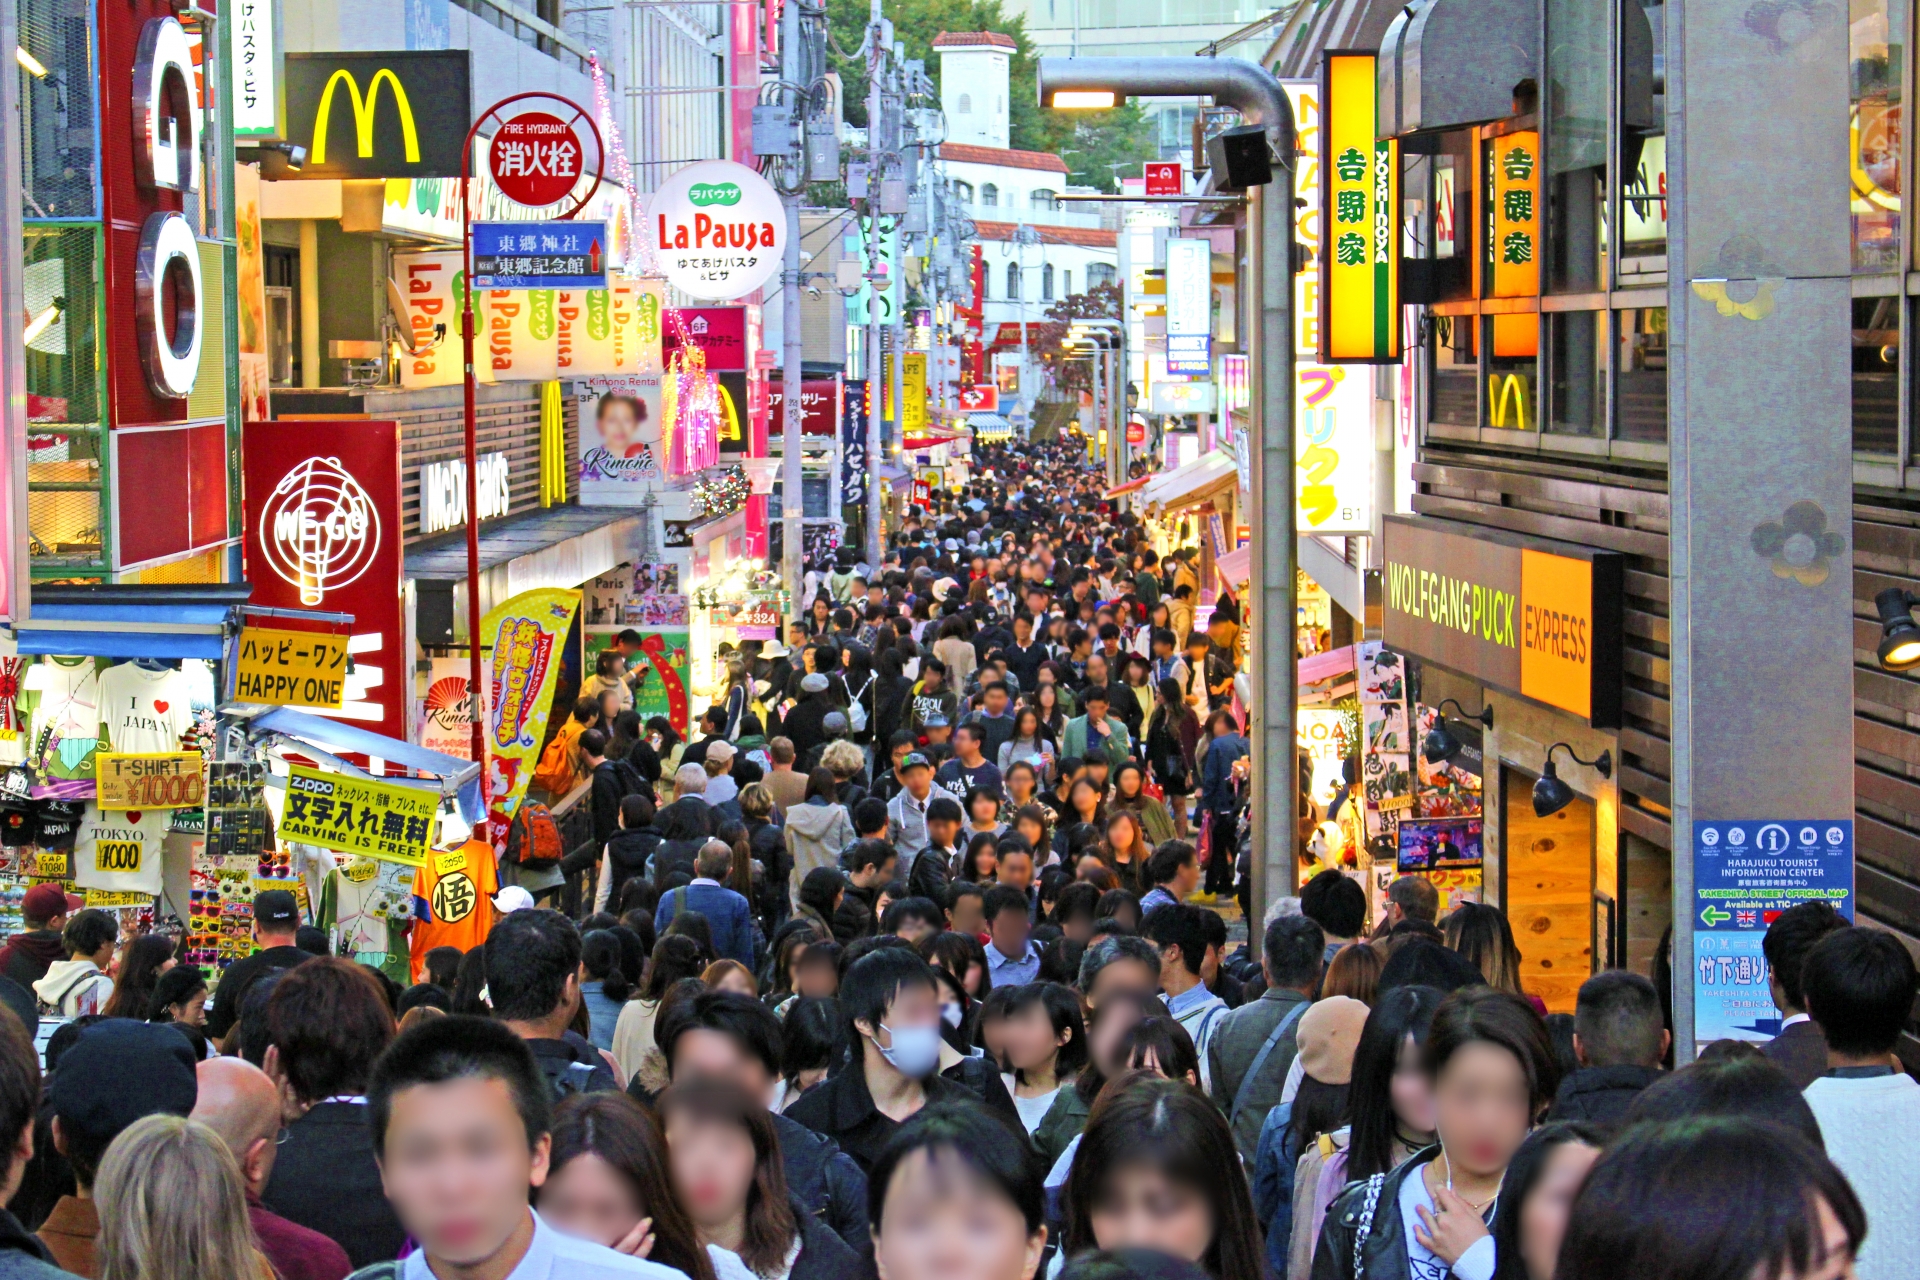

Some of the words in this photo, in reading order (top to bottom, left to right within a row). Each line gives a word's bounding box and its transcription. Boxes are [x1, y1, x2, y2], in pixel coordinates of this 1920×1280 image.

[504, 124, 524, 134] FIRE
[527, 124, 567, 134] HYDRANT
[497, 140, 577, 177] 消火栓
[658, 213, 689, 250] La
[694, 213, 775, 252] Pausa
[498, 235, 579, 252] 東郷神社
[499, 257, 585, 274] 東郷記念館
[407, 263, 442, 294] La
[491, 303, 520, 370] Pausa
[589, 378, 626, 386] Kimono
[628, 378, 659, 386] Rental
[580, 395, 594, 403] 3F
[612, 388, 636, 396] Shop
[1299, 365, 1346, 527] プリクラ
[844, 442, 867, 503] ハセガワ
[1342, 507, 1362, 521] B1
[595, 578, 625, 589] Paris
[1389, 561, 1470, 634] WOLFGANG
[1473, 584, 1515, 649] PUCK
[1525, 604, 1586, 665] EXPRESS
[242, 638, 345, 670] ハッピーワン
[237, 672, 300, 701] HAPPY
[303, 677, 342, 704] ONE
[130, 696, 138, 710] I
[122, 715, 171, 735] JAPAN
[452, 723, 474, 731] TOK
[1308, 742, 1347, 761] AFE
[110, 758, 184, 776] T-SHIRT
[124, 772, 204, 806] ¥1000
[291, 775, 334, 795] Zippo
[172, 819, 204, 830] JAPAN
[285, 791, 430, 847] 文字入れ無料
[43, 822, 71, 836] JAPAN
[282, 820, 347, 844] CARVING
[354, 835, 372, 848] IS
[98, 843, 140, 870] ¥1000
[1727, 859, 1777, 867] HARAJUKU
[1779, 859, 1819, 867] TOURIST
[1789, 868, 1824, 876] CENTER
[435, 876, 474, 921] 悟
[1699, 889, 1749, 898] TAKESHITA
[1750, 889, 1785, 898] STREET
[1786, 889, 1826, 898] OFFICIAL
[1828, 889, 1848, 898] MAP
[1699, 956, 1769, 985] 竹下通り
[1722, 999, 1775, 1008] ご自由にお
